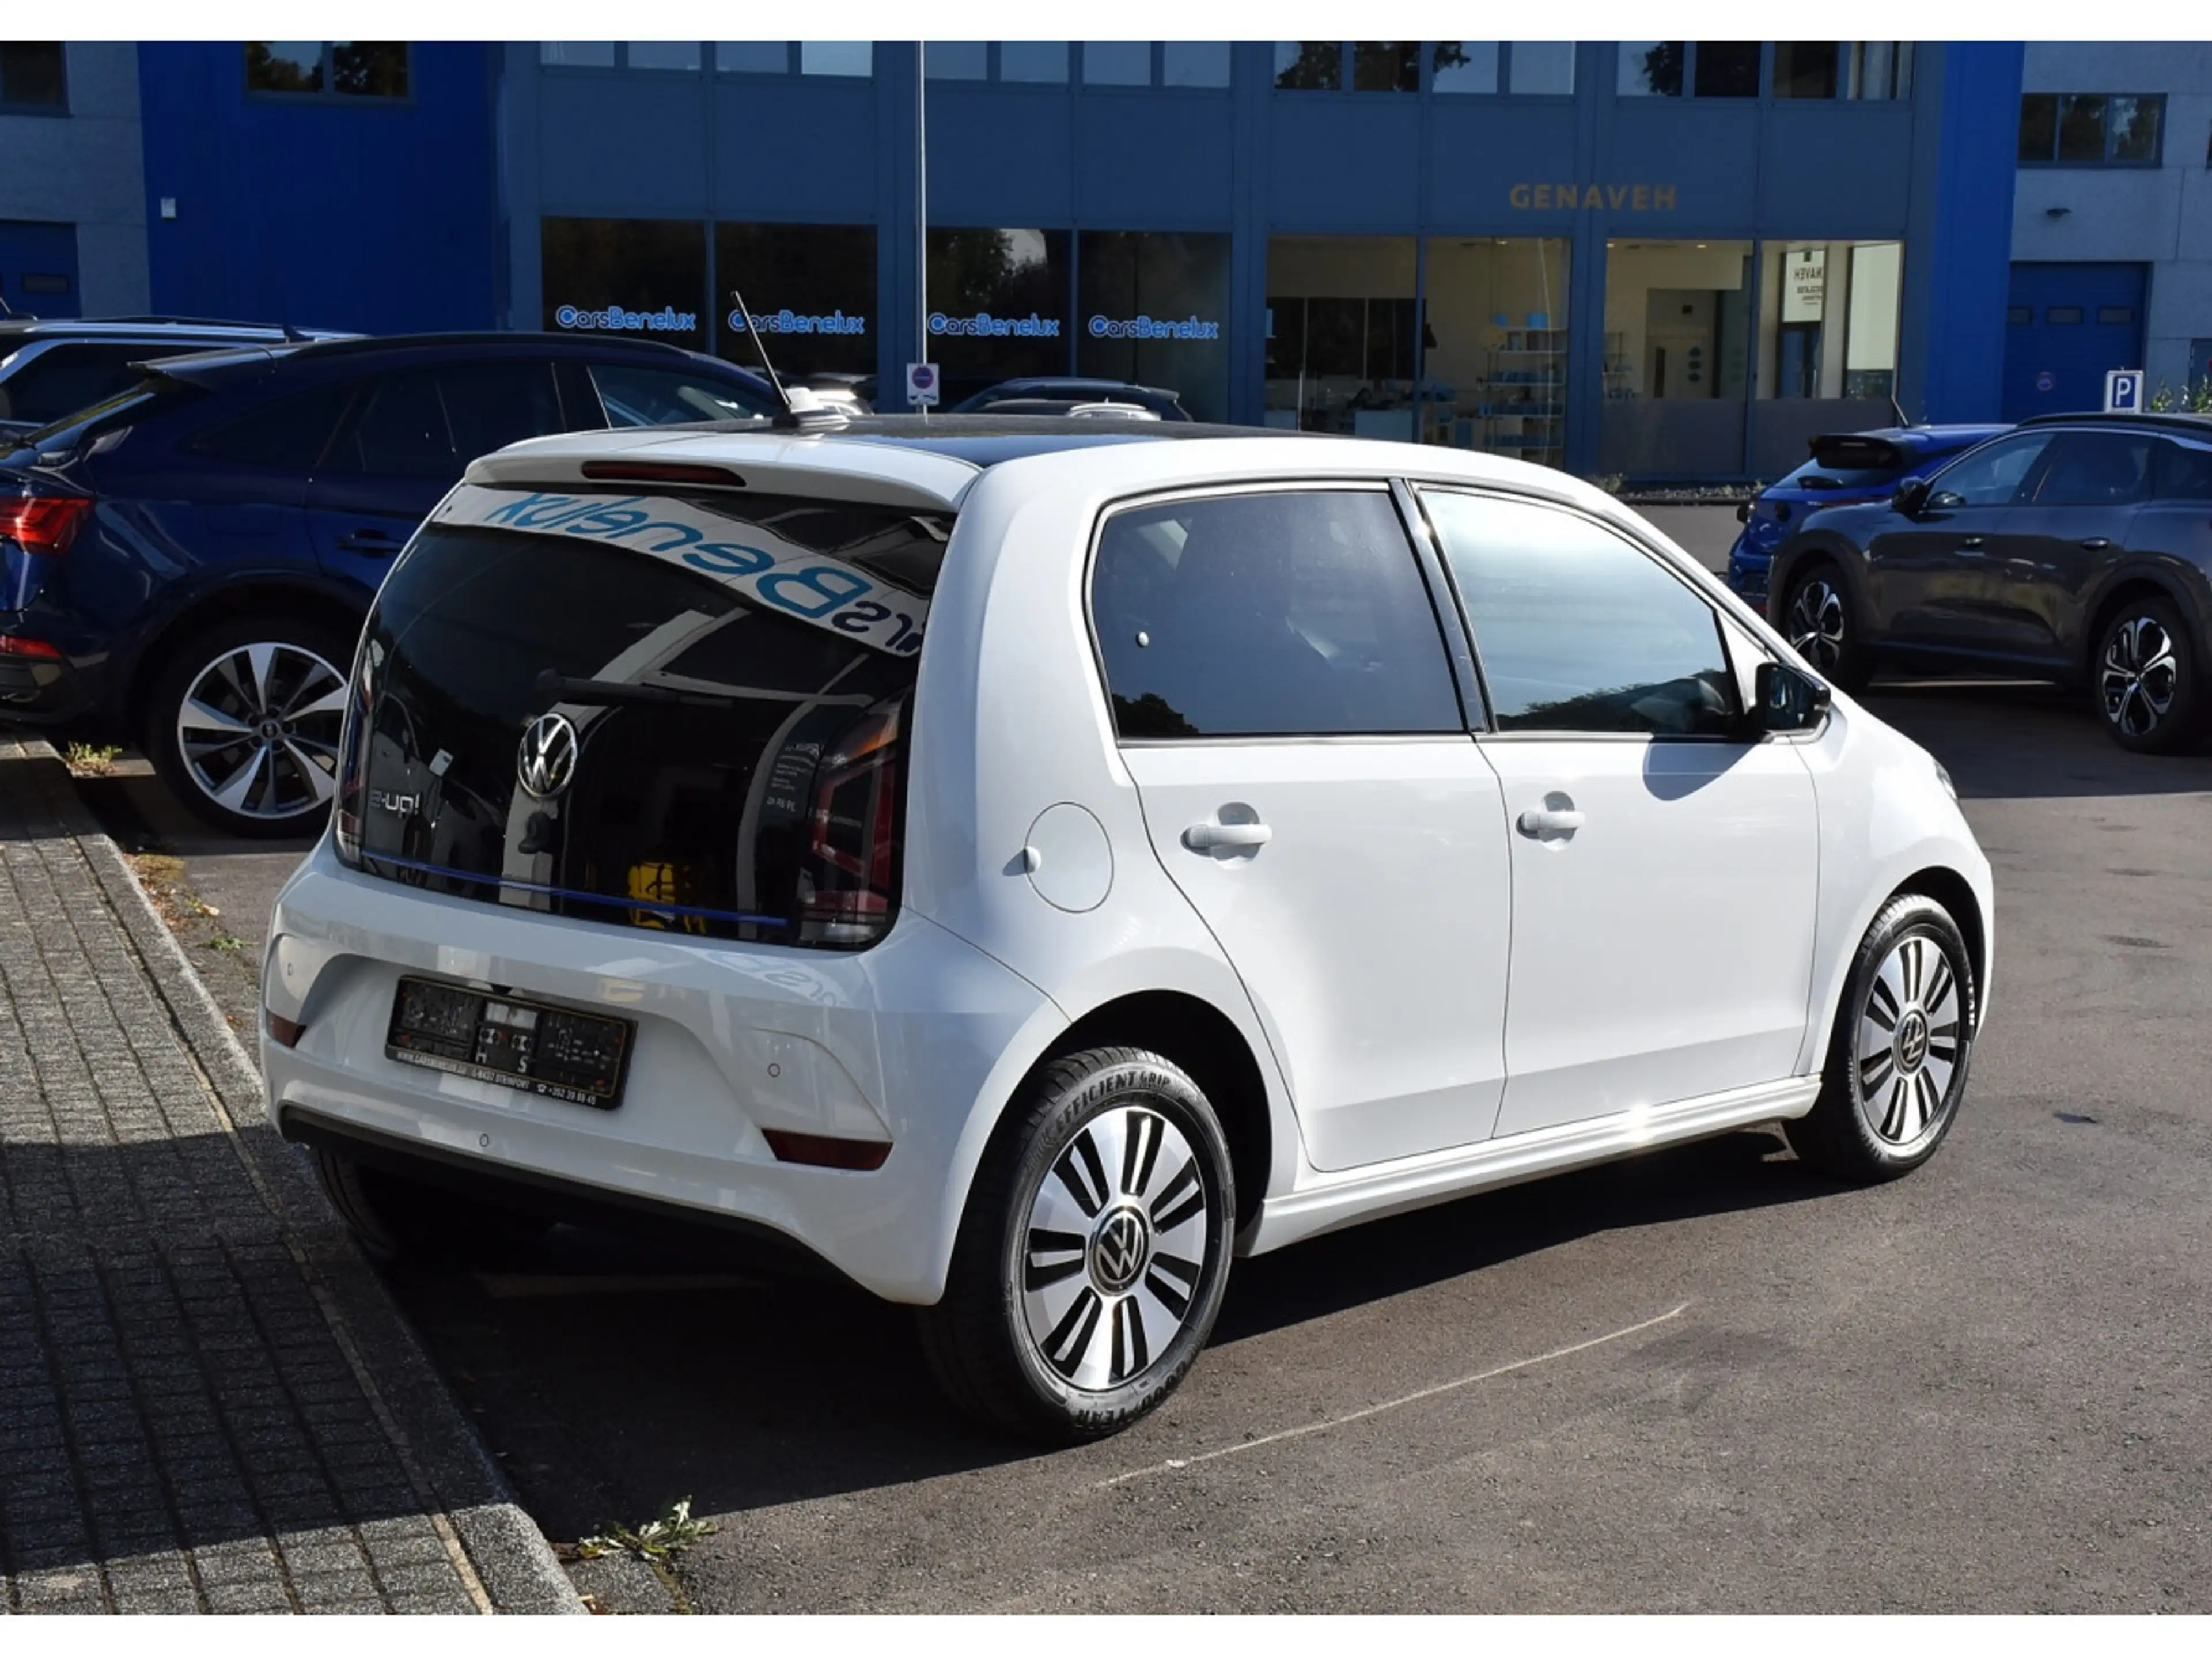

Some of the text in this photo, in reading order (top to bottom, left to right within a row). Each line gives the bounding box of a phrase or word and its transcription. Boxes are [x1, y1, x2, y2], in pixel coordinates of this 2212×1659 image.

[1509, 182, 1677, 210] GENAVEH
[555, 304, 696, 331] CarsBenelux
[728, 309, 865, 334] CarsBenelux
[927, 312, 1060, 337] CarsBenelux
[1088, 315, 1218, 339] CarsBenelux
[2116, 377, 2131, 406] P
